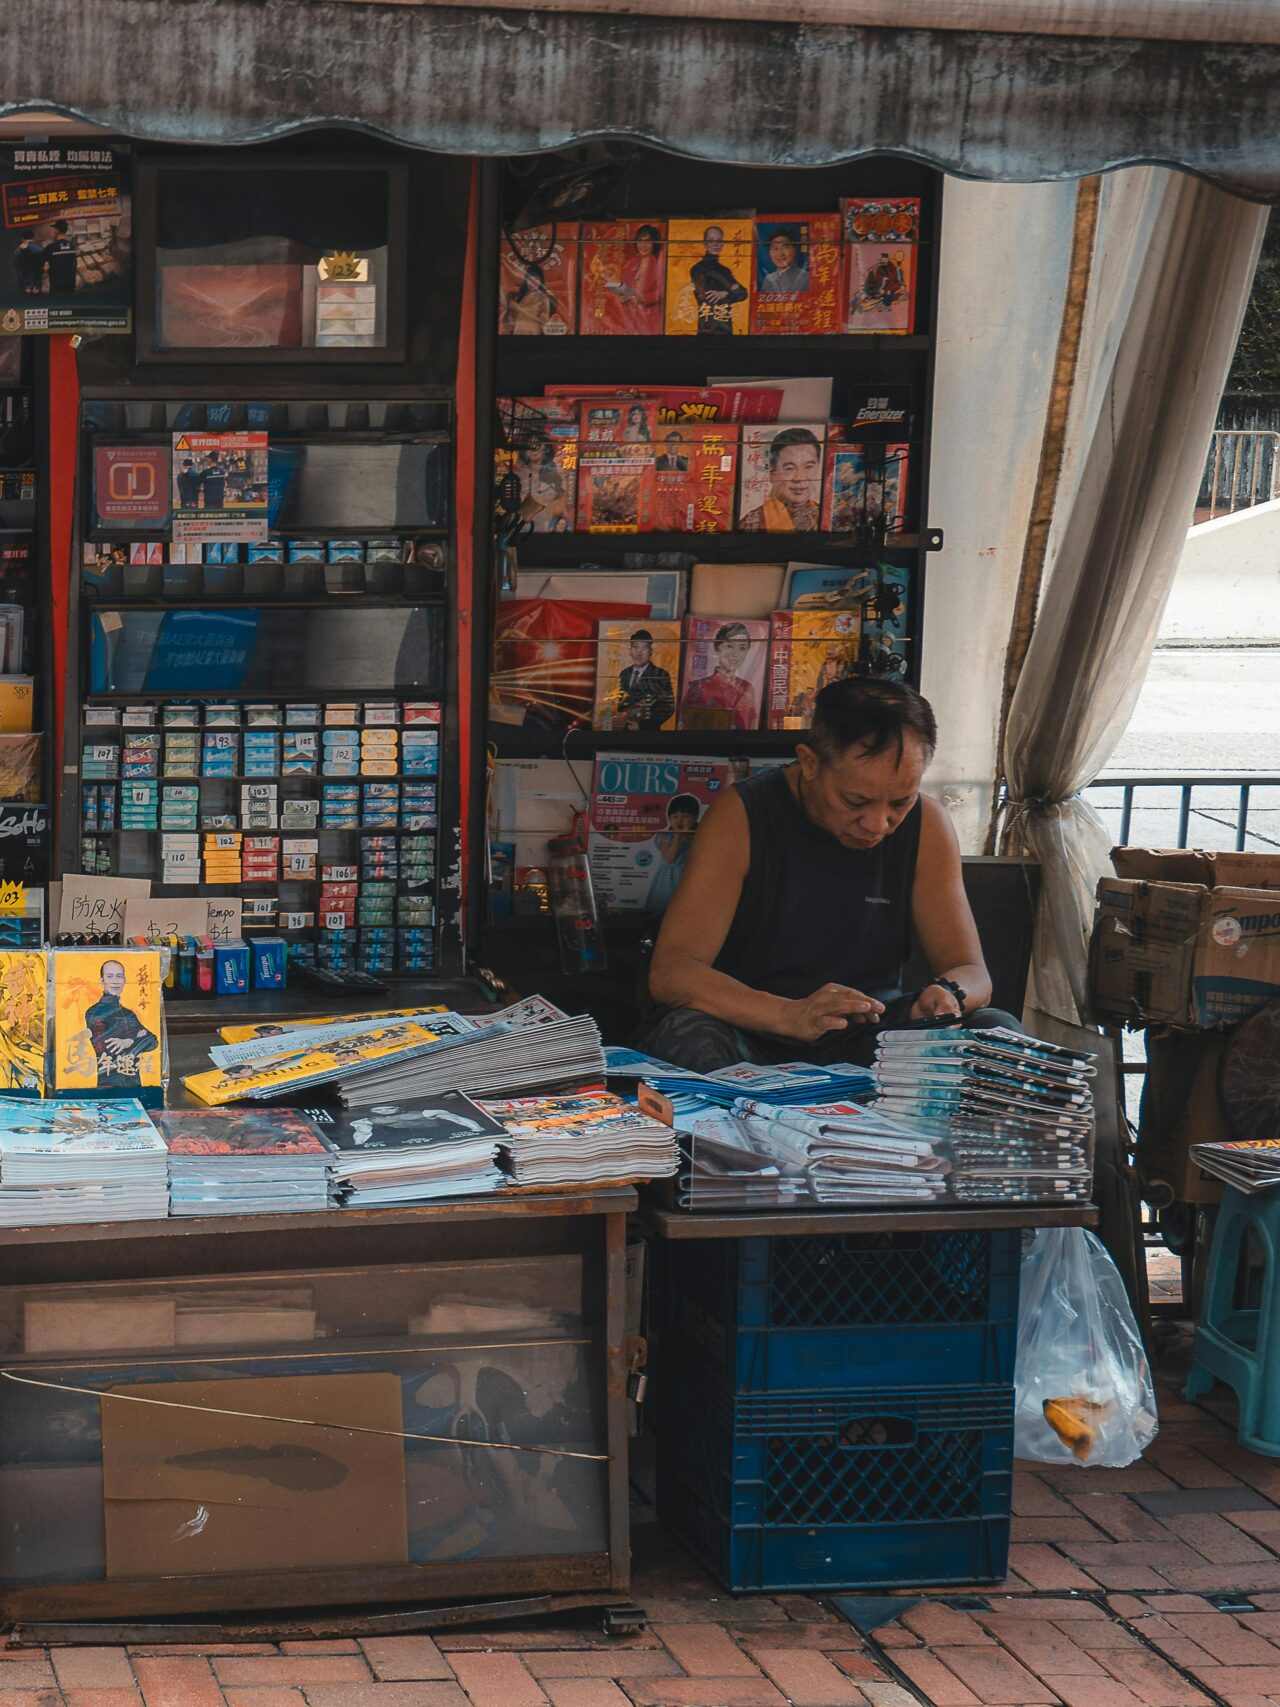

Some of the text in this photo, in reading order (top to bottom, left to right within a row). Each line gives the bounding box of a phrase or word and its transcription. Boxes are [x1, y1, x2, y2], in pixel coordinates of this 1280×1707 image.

[856, 408, 906, 422] Energizer
[129, 735, 154, 748] NEXT
[218, 737, 229, 747] 93
[299, 737, 312, 746] 105
[126, 749, 152, 763] NEXT
[336, 751, 350, 760] 102
[126, 763, 151, 777] NEXT
[600, 762, 680, 794] OURS
[253, 788, 268, 796] 103
[220, 837, 235, 845] 102
[171, 853, 185, 862] 110
[295, 859, 306, 870] 91
[335, 868, 349, 878] 106
[0, 891, 20, 904] 103
[207, 902, 235, 923] Tempo
[292, 916, 302, 926] 96
[328, 915, 343, 925] 109
[210, 925, 233, 939] $4
[224, 961, 235, 985] Tempo
[261, 954, 272, 979] Tempo
[210, 1059, 321, 1092] WARNING
